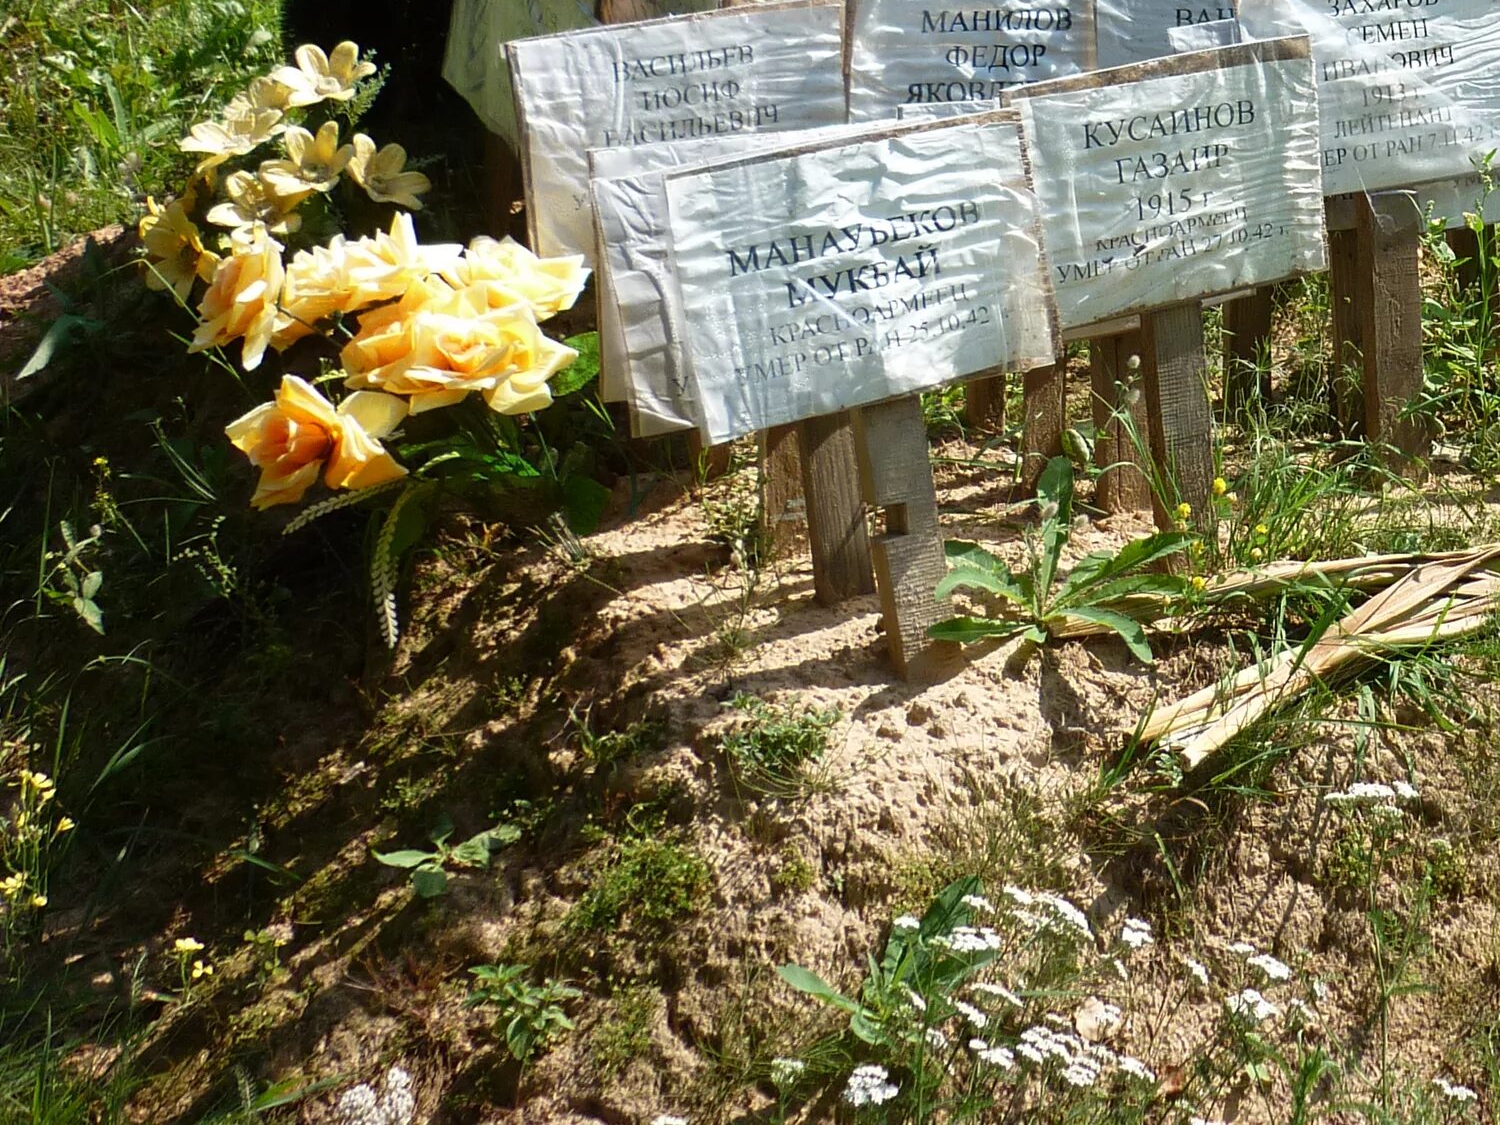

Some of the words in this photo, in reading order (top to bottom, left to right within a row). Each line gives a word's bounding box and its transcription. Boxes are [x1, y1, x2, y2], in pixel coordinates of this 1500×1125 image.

[921, 7, 1073, 35] МАНИЛОВ
[1175, 7, 1235, 28] ВАН
[1345, 17, 1430, 46] СЕМЕН
[611, 44, 755, 84] ВАСИЛЬЕВ
[945, 43, 1047, 74] ФЕДОР
[1322, 44, 1455, 82] ИВАНОВИЧ
[641, 80, 741, 112] ИОСИФ
[603, 103, 779, 147] ВАСИЛЬЕВИЧ
[1083, 99, 1256, 150] КУСАИНОВ
[1116, 142, 1230, 185] ГАЗАИР
[1323, 146, 1347, 167] ЕР
[1352, 142, 1381, 163] ОТ
[1386, 133, 1422, 158] РАН
[1135, 187, 1193, 222] 1915
[784, 242, 945, 309] МУКБАЙ
[770, 282, 970, 347] КРАСНОАРМЕЕЦ
[814, 342, 846, 367] ОТ
